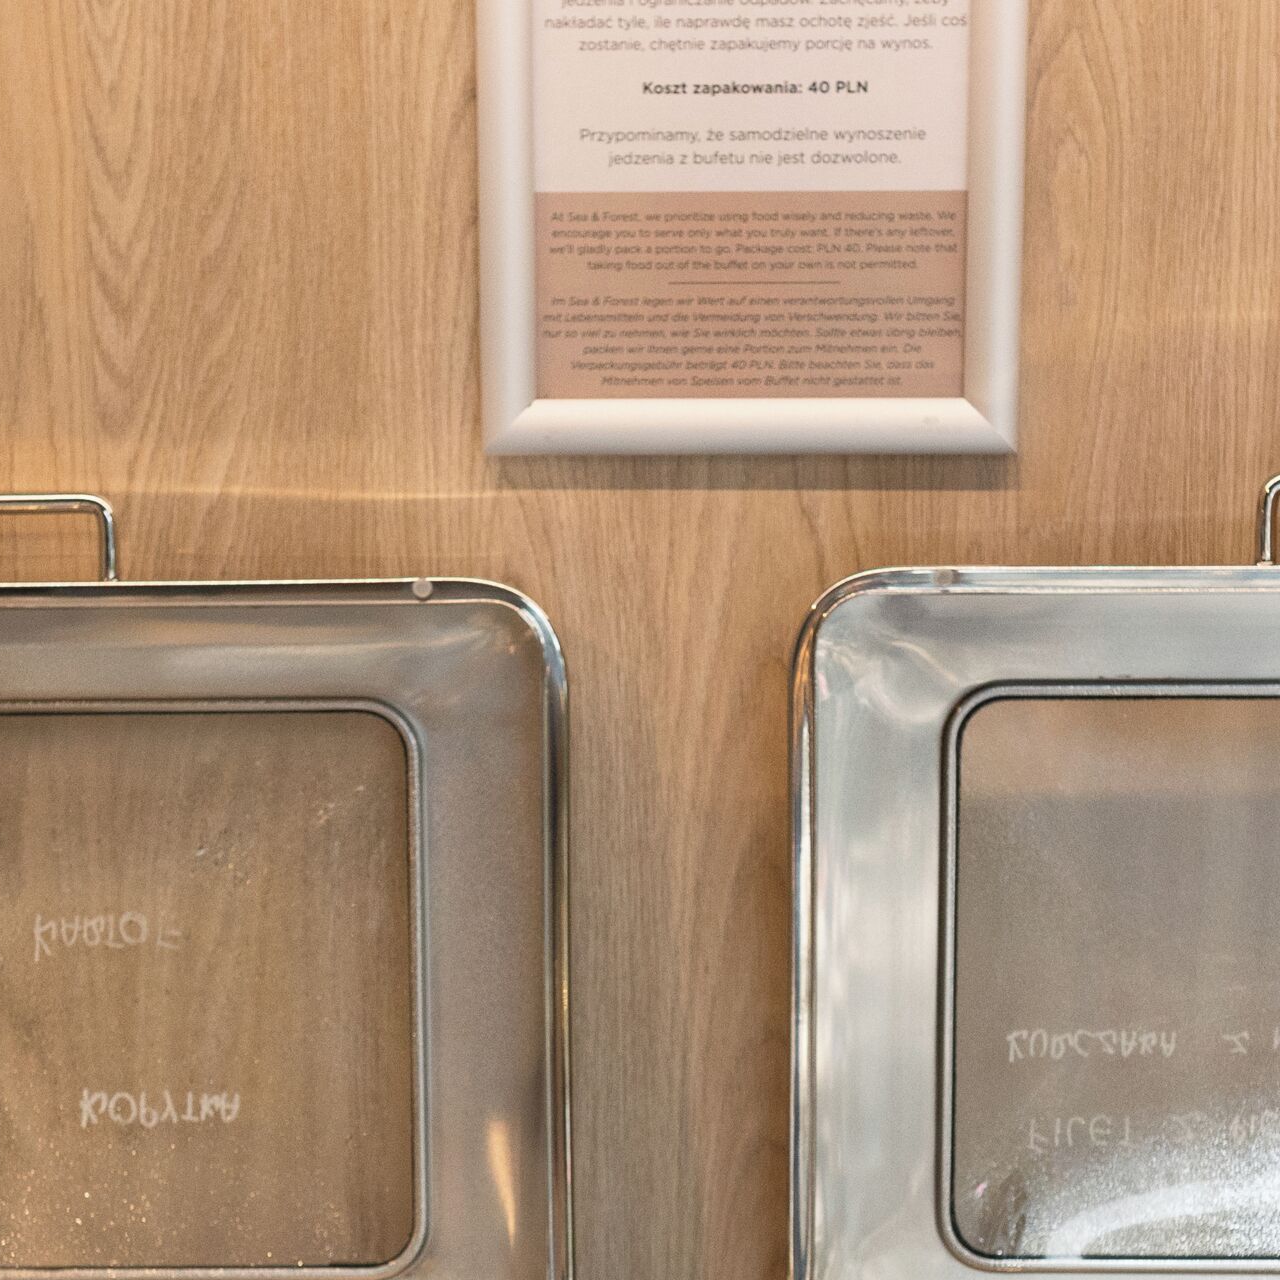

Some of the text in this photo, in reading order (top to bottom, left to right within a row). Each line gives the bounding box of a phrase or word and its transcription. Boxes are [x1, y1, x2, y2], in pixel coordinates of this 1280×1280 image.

[544, 14, 968, 32] nakładać tyle, ile naprawdę masz ochotę zjeść. Jeśli coś
[579, 36, 934, 54] zostanie, chętnie zapakujemy porcję na wynos.
[643, 81, 870, 98] Koszt zapakowania: 40 PLN
[580, 127, 927, 145] Przypominamy, że samodzielne wynoszenie
[609, 151, 903, 168] jedzenia z bufetu nie jest dozwolone.
